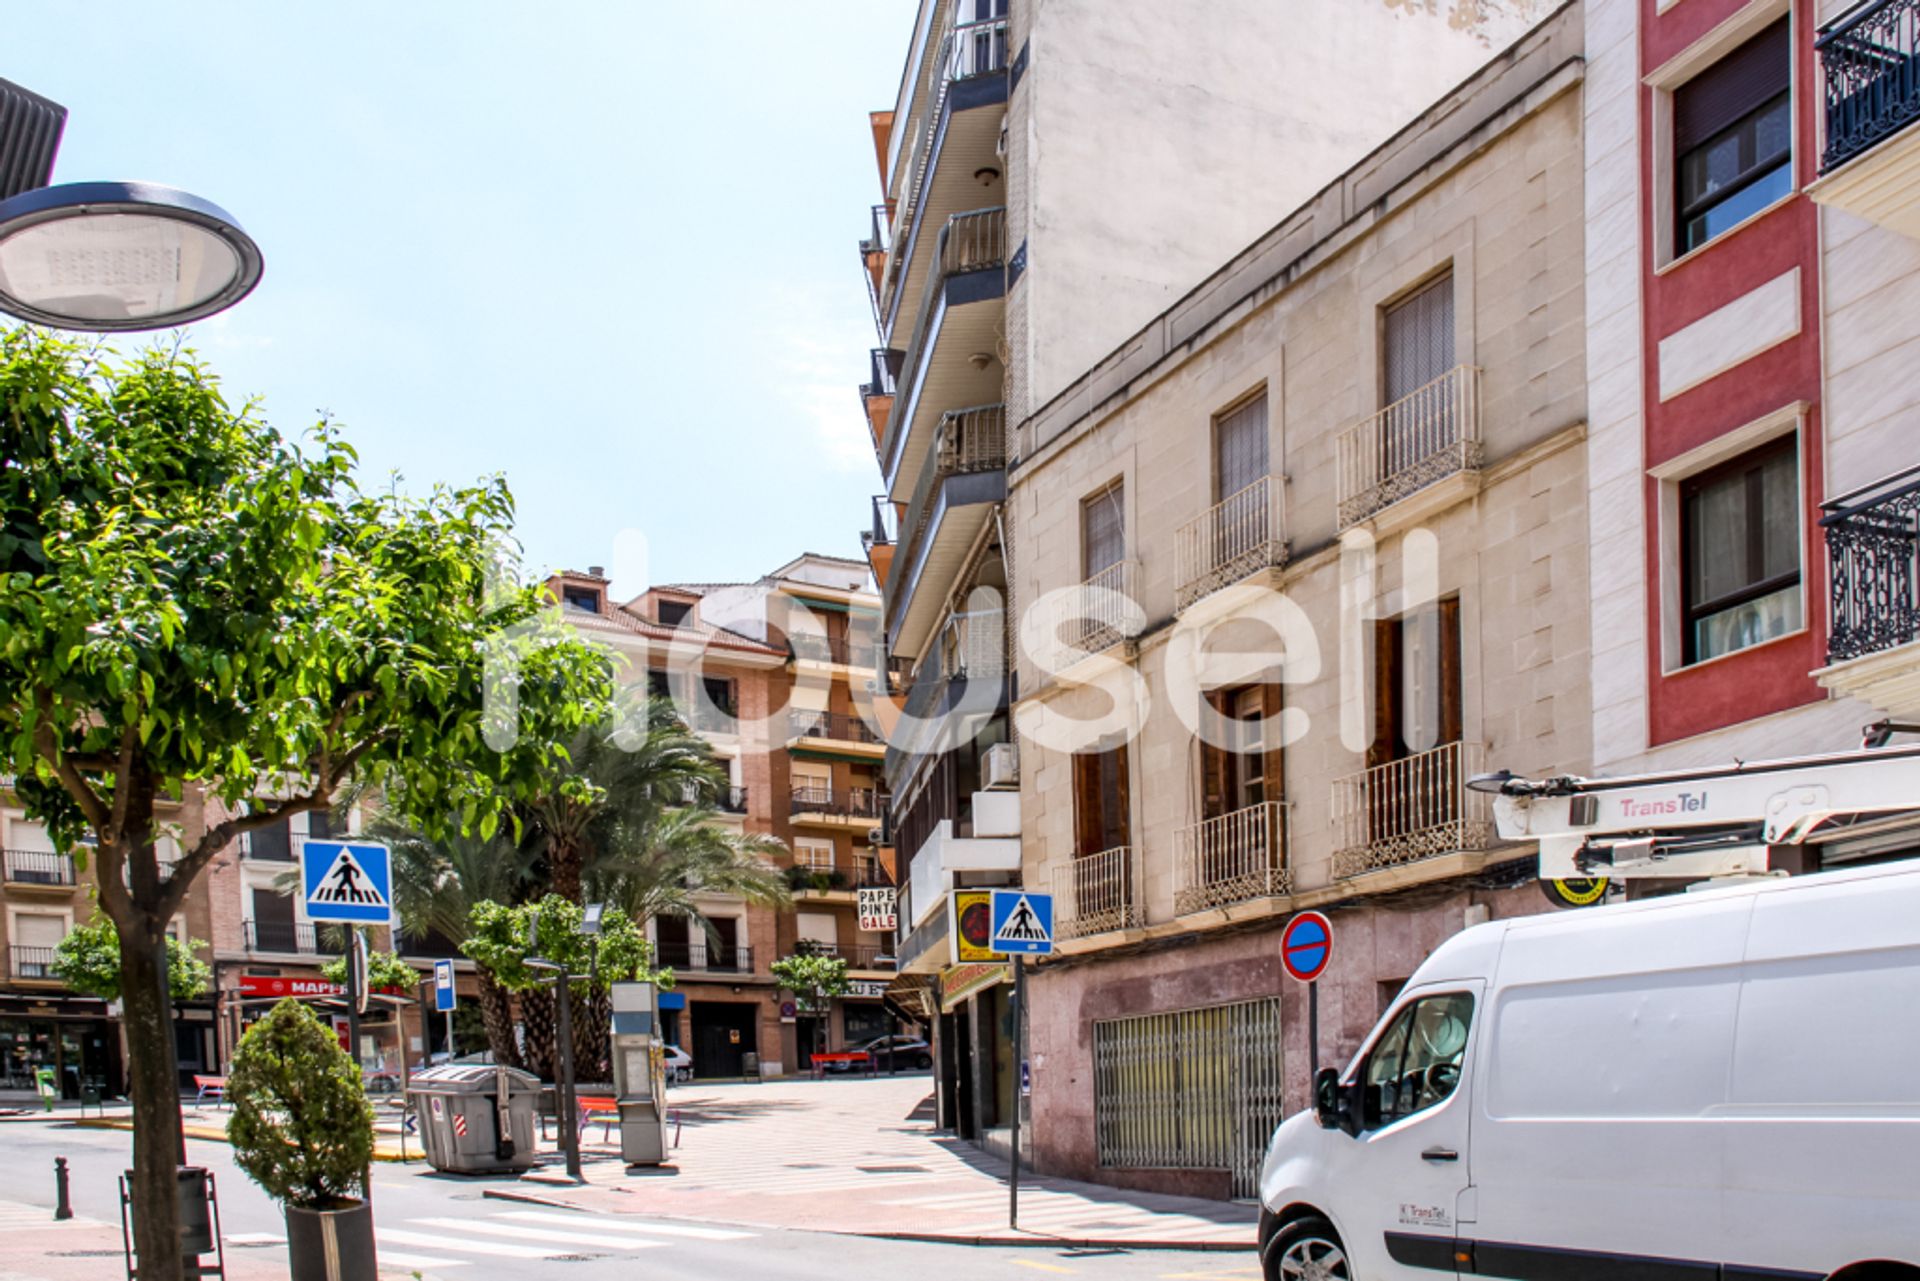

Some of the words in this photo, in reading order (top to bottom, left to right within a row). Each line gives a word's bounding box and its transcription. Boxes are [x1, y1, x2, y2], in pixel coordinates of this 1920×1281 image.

[1620, 791, 1707, 817] TransTel
[860, 889, 895, 902] PAPE
[861, 915, 896, 929] GALE
